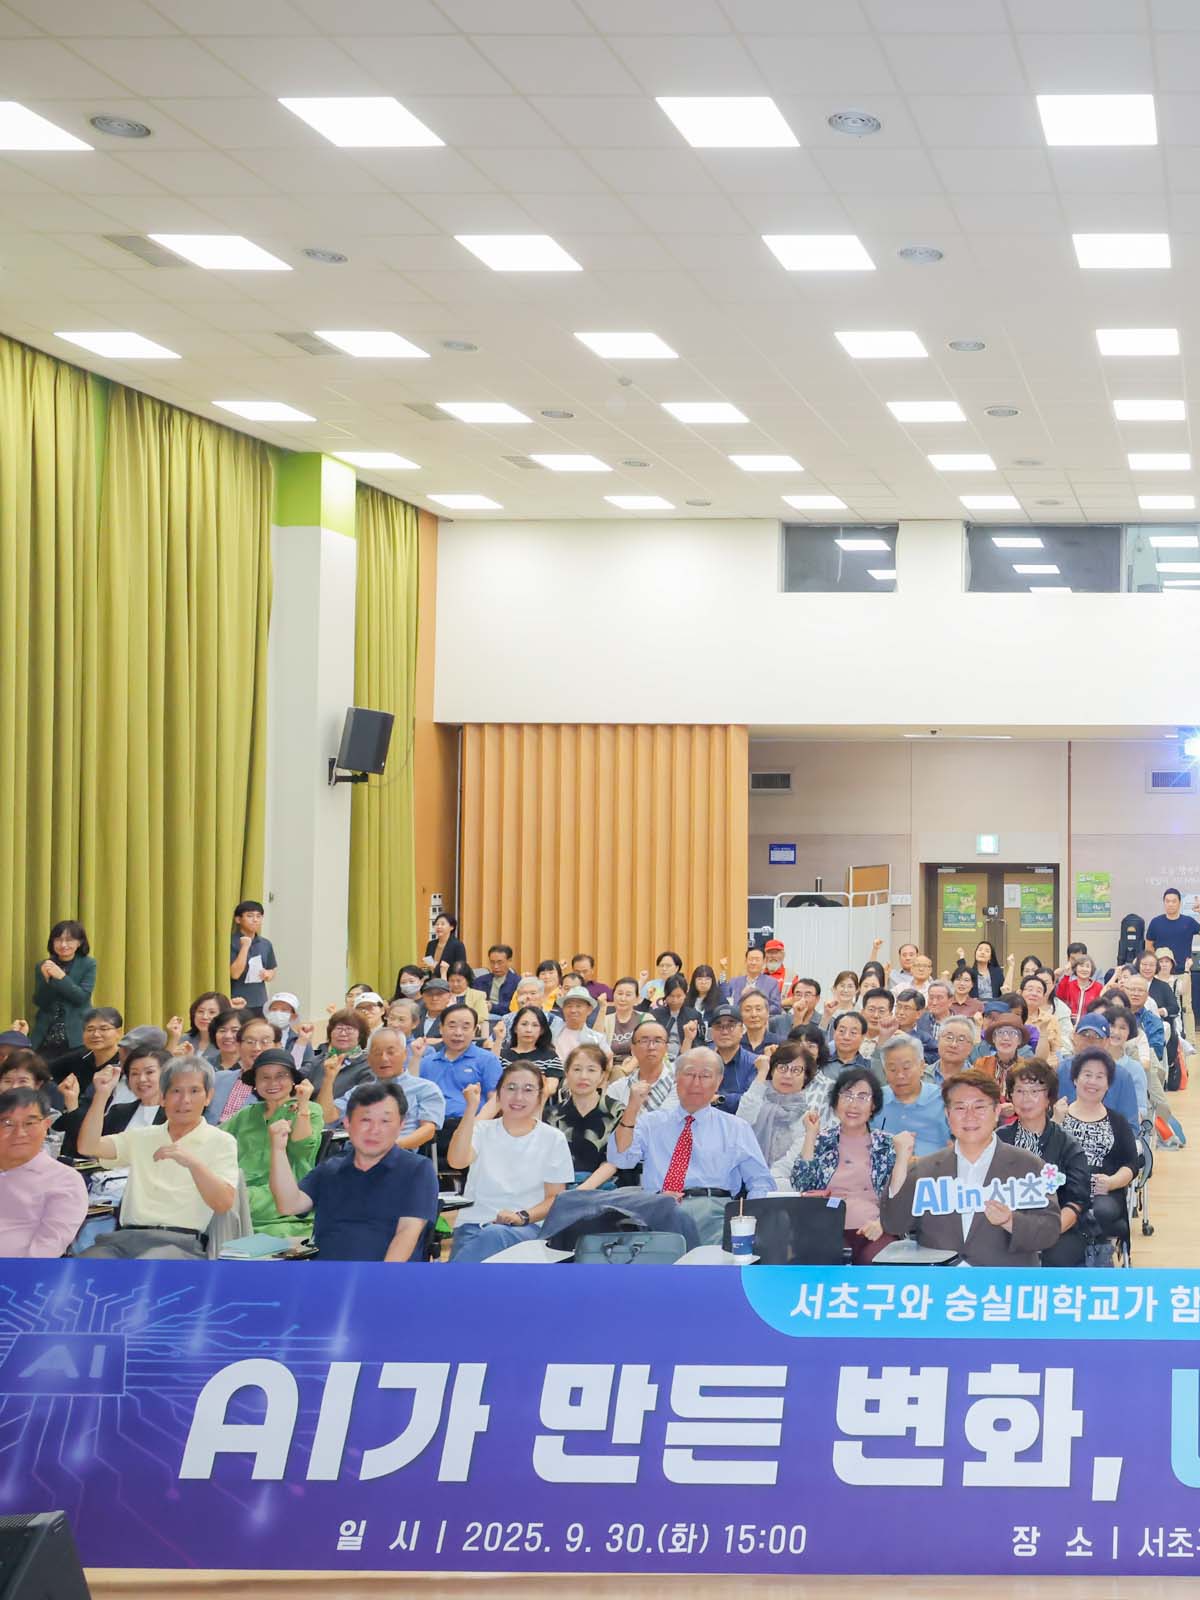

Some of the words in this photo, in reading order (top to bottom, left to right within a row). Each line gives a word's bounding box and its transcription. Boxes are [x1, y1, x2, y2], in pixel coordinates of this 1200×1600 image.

[914, 1180, 949, 1214] AI
[957, 1184, 982, 1208] in
[989, 1175, 1048, 1208] 서초
[790, 1283, 933, 1321] 서초구와
[945, 1284, 1158, 1322] 숭실대학교가
[18, 1344, 106, 1378] AI
[178, 1358, 491, 1482] AI가
[533, 1363, 788, 1485] 만든
[832, 1364, 1124, 1502] 변화,
[462, 1521, 550, 1553] 2025.
[565, 1523, 591, 1553] 9.
[606, 1522, 709, 1554] 30.(화)
[724, 1524, 807, 1554] 15:00
